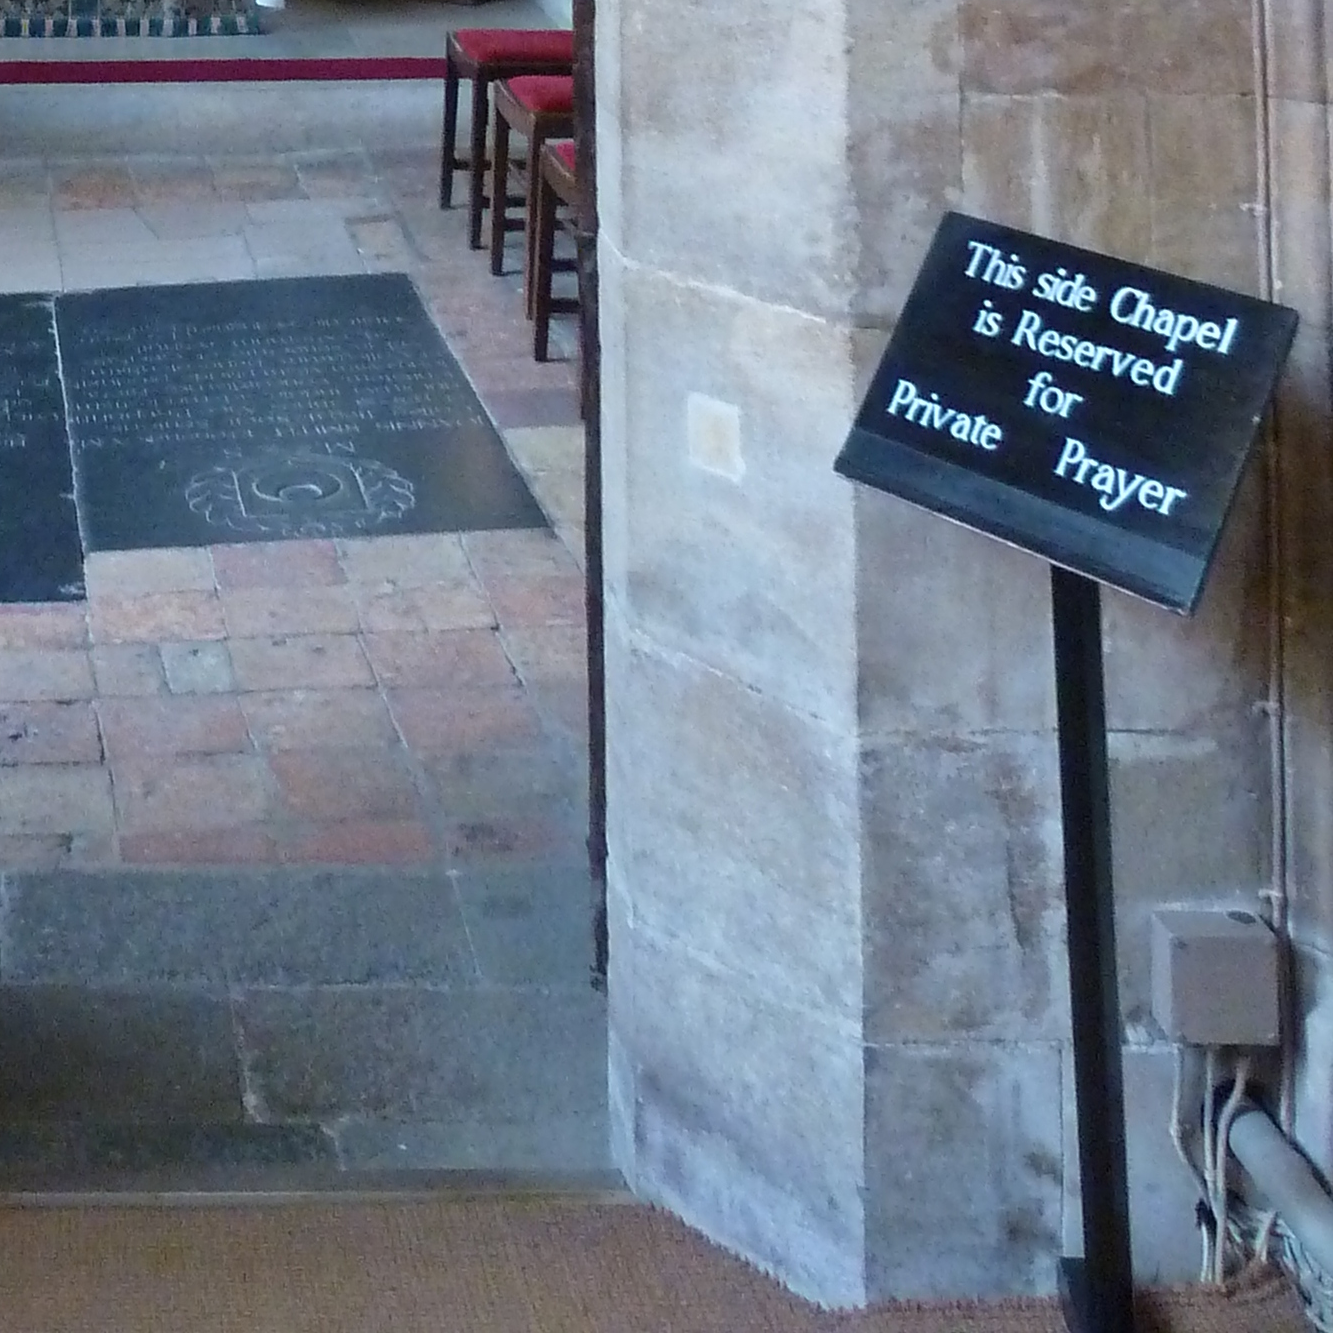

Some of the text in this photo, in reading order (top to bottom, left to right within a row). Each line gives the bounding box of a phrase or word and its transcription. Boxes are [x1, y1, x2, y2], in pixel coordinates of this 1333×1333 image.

[964, 240, 1239, 355] This side Chapel
[972, 299, 1185, 396] is Reserved
[886, 379, 1188, 515] Private Prayer
[1022, 371, 1084, 419] for
